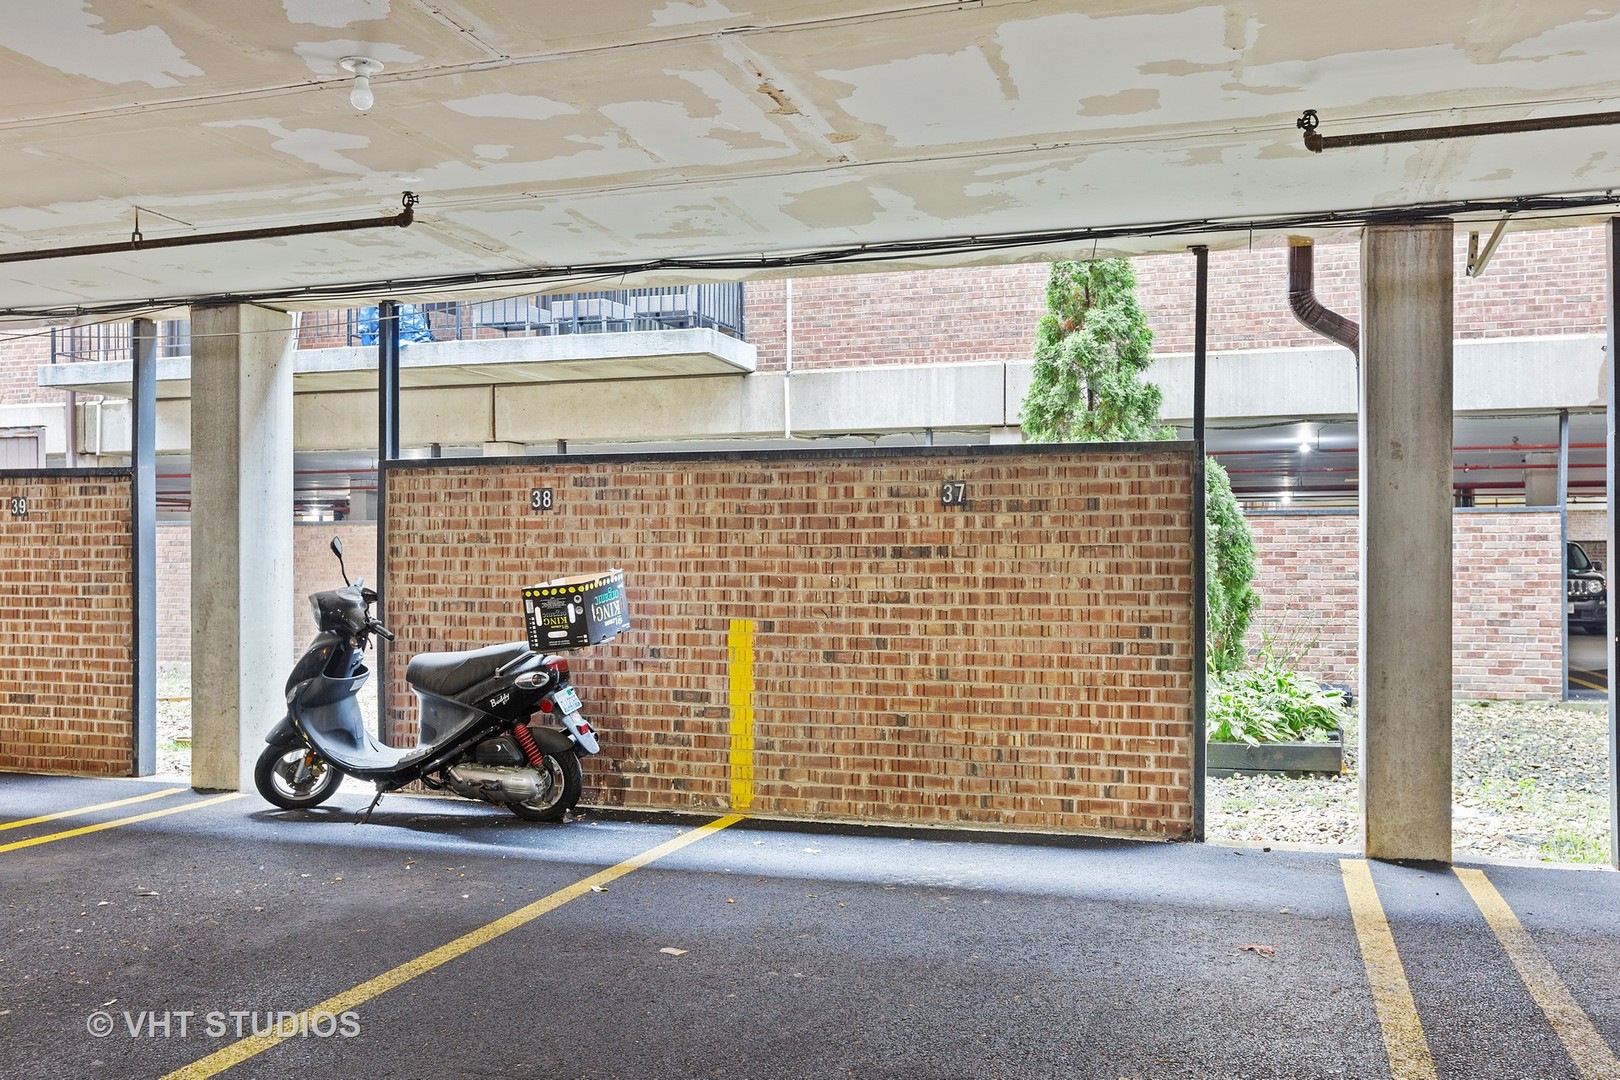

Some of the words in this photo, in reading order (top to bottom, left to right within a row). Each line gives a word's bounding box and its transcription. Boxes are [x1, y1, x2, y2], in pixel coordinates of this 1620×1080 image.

[532, 490, 551, 508] 38
[942, 483, 965, 503] 37
[11, 498, 26, 514] 39
[594, 587, 620, 605] organic
[596, 599, 622, 622] KING
[543, 616, 568, 626] KING
[490, 693, 510, 708] Buddy
